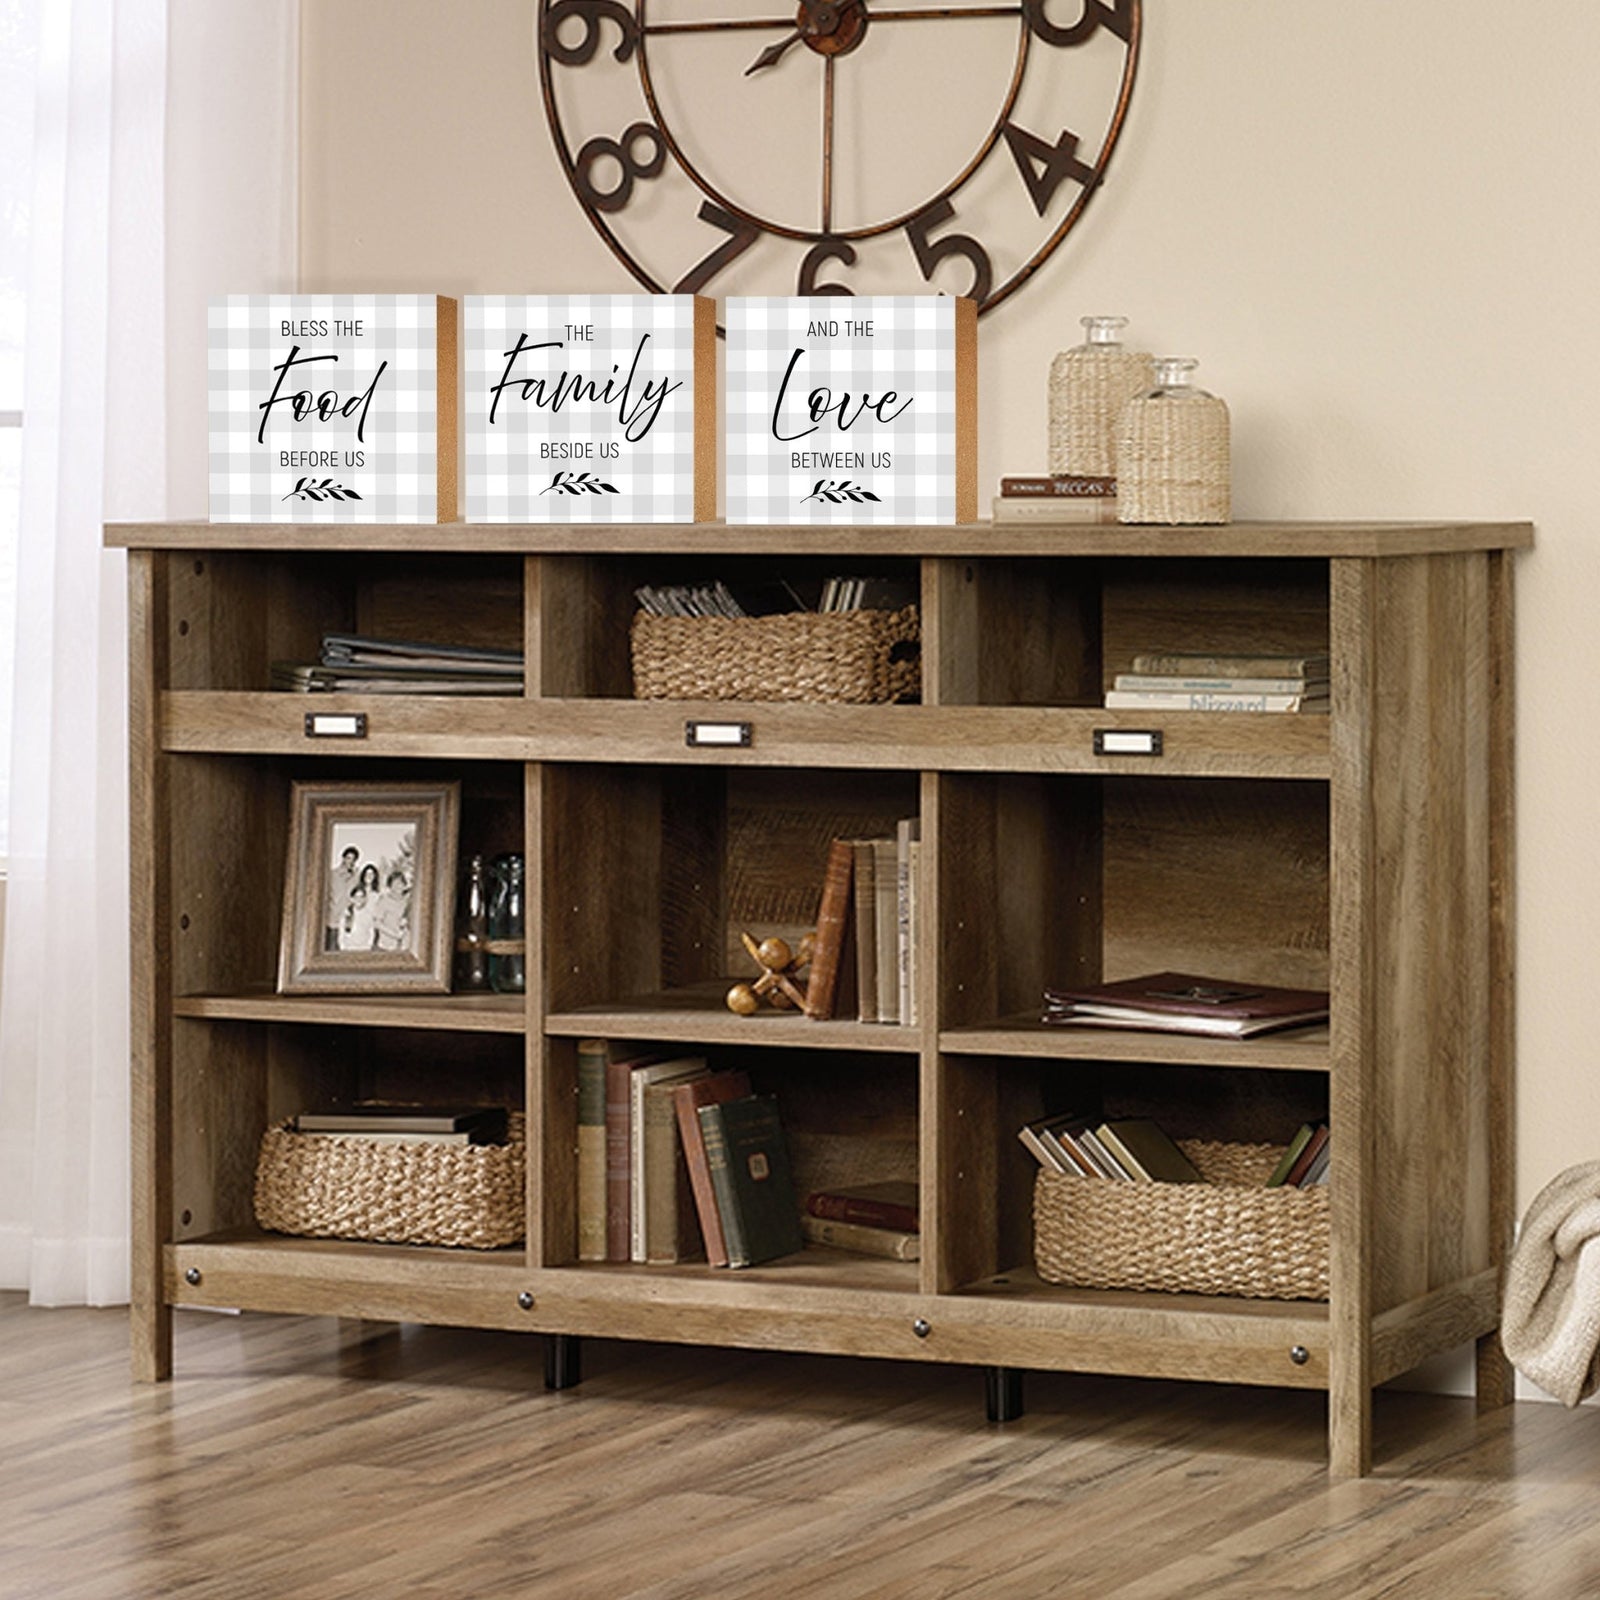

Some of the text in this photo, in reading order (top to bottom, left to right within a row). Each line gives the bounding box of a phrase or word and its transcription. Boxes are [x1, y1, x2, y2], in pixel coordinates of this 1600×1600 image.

[576, 122, 667, 213] 8
[1001, 119, 1104, 217] 4
[672, 200, 761, 296] 7
[903, 199, 993, 306] 5
[281, 320, 364, 337] BLESS THE
[564, 324, 594, 342] THE
[806, 320, 874, 337] AND THE
[258, 345, 388, 444] Food
[490, 332, 683, 443] Family
[771, 347, 914, 442] Love
[280, 450, 365, 468] BEFORE US
[540, 442, 620, 459] BESIDE US
[791, 452, 891, 469] BETWEEN US
[1189, 693, 1267, 713] blizzard
